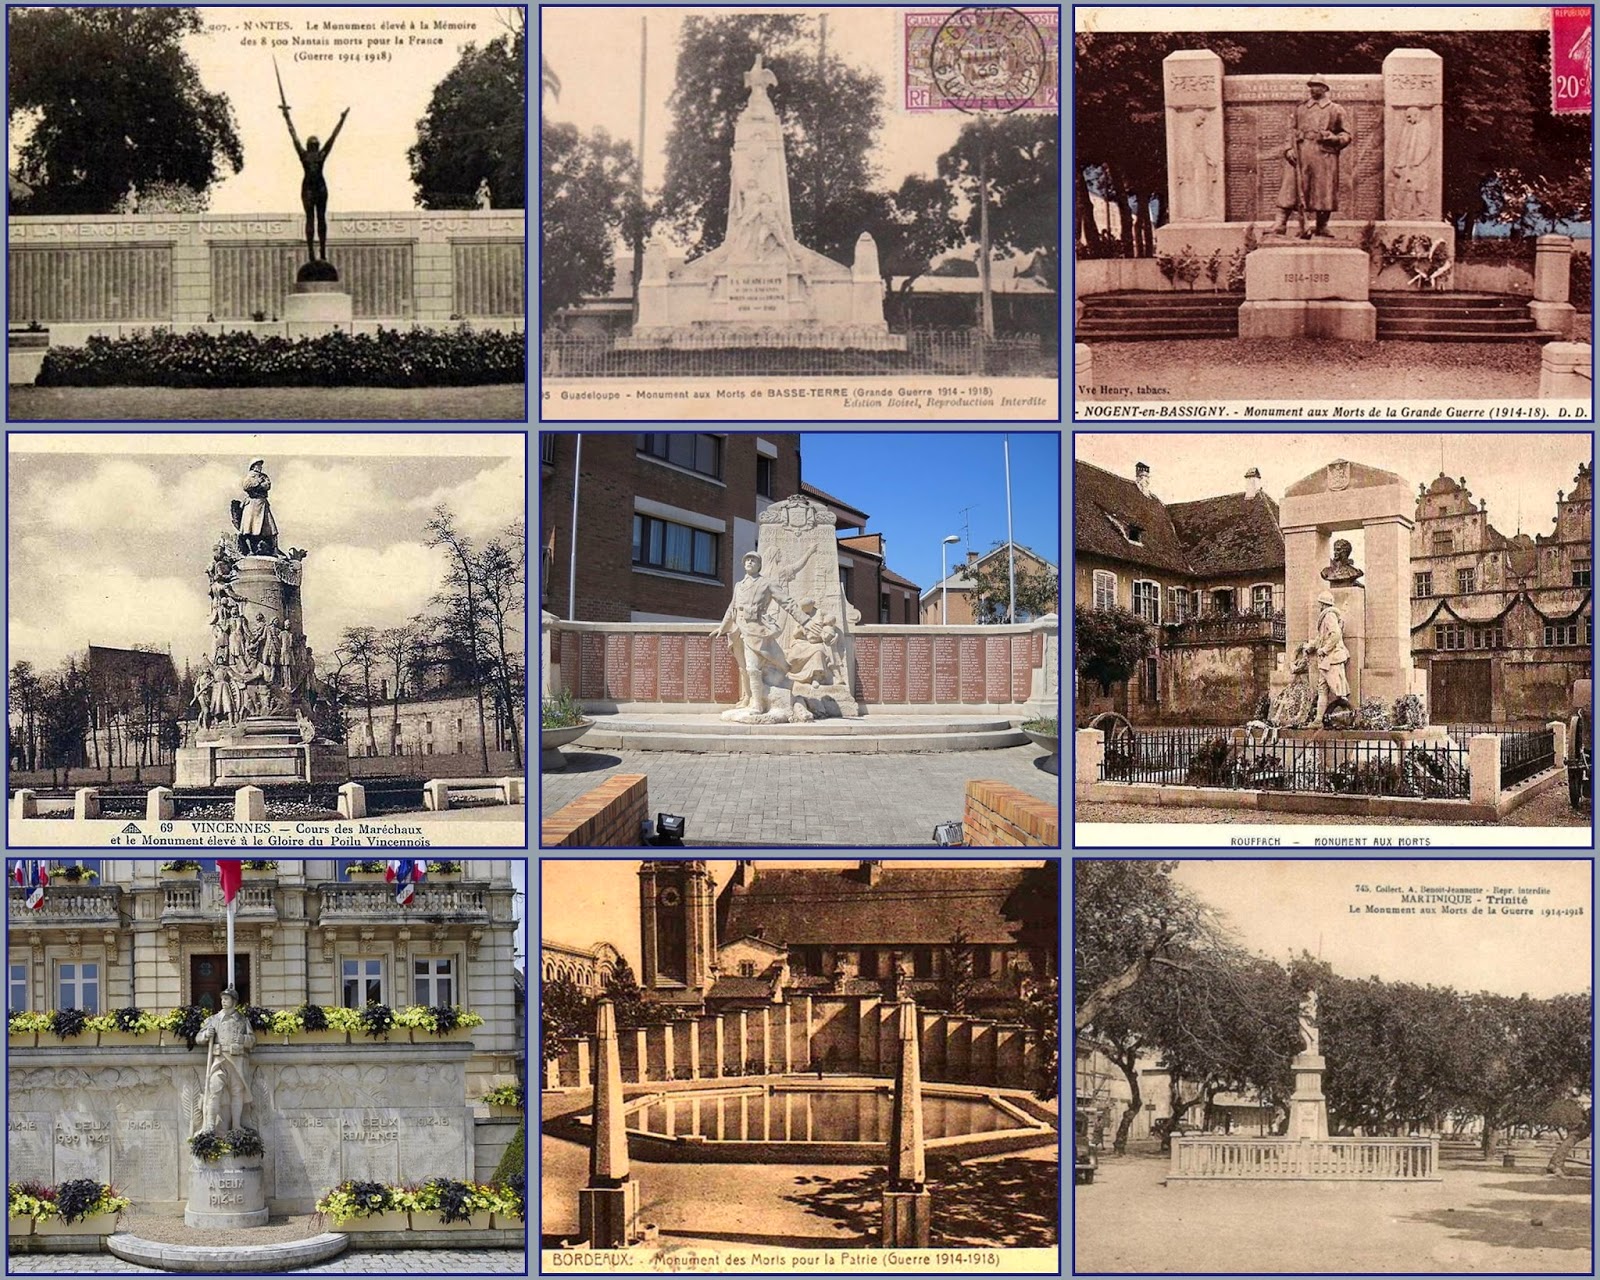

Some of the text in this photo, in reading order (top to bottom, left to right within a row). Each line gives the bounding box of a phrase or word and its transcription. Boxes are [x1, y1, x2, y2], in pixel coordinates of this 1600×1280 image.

[306, 20, 319, 31] Le
[323, 21, 376, 31] Monument
[380, 20, 406, 31] élevé
[409, 20, 415, 31] à
[420, 20, 429, 31] la
[433, 20, 477, 31] Mémoire
[240, 36, 444, 49] des 8 500 Nantais morts pour la France
[293, 51, 334, 62] (Guerre
[33, 224, 57, 239] LA
[154, 221, 192, 237] DES
[199, 220, 284, 236] NANTAIS
[340, 218, 407, 234] MORTS
[420, 218, 473, 233] POUR
[488, 217, 517, 233] LA
[1284, 273, 1330, 283] 1914-1918
[560, 391, 621, 401] Guadeloupe
[636, 389, 689, 400] Monument
[693, 391, 711, 399] aux
[716, 389, 746, 399] Morts
[750, 389, 763, 399] de
[767, 387, 848, 398] BASSE-TERRE
[852, 387, 893, 399] (Grande
[897, 387, 933, 398] Guerre
[938, 387, 958, 397] 1914
[968, 386, 993, 397] 1918)
[1100, 385, 1133, 397] Henry,
[1136, 385, 1170, 396] tabacs.
[926, 397, 994, 409] Reproduction
[1000, 396, 1048, 408] Interdite
[1084, 405, 1229, 418] NOGENT-en-BASSIGNY.
[1243, 405, 1304, 418] Monument
[1307, 408, 1329, 418] aux
[1332, 405, 1366, 418] Morts
[1368, 406, 1382, 418] de
[1386, 405, 1397, 418] la
[1401, 405, 1443, 418] Grande
[1446, 406, 1486, 419] Guerre
[1489, 406, 1550, 420] (1914-18).
[1558, 406, 1571, 419] D.
[1575, 406, 1588, 419] D.
[160, 822, 174, 834] 69
[295, 823, 330, 835] Cours
[334, 823, 353, 834] des
[359, 823, 422, 835] Maréchaux
[110, 835, 431, 847] et le Monument élevé à le Gloire du Poilu Vincennois
[1314, 837, 1368, 847] MONUMENT
[1373, 837, 1392, 847] AUX
[1398, 837, 1431, 847] MORTS
[1401, 894, 1472, 905] MARTINIQUE
[1486, 895, 1528, 905] Trinité
[1349, 905, 1361, 914] Le
[1365, 905, 1416, 914] Monument
[1441, 905, 1467, 915] Morts
[1472, 906, 1483, 915] de
[1488, 906, 1496, 915] la
[1501, 906, 1534, 915] Guerre
[1541, 907, 1584, 917] 1914-1918
[218, 1179, 245, 1190] CEUX
[653, 1254, 720, 1266] Monument
[725, 1253, 746, 1266] des
[751, 1253, 786, 1266] Morts
[792, 1254, 820, 1268] pour
[824, 1252, 835, 1265] la
[841, 1252, 878, 1265] Patrie
[882, 1252, 931, 1267] (Guerre
[935, 1252, 1000, 1267] 1914-1918)
